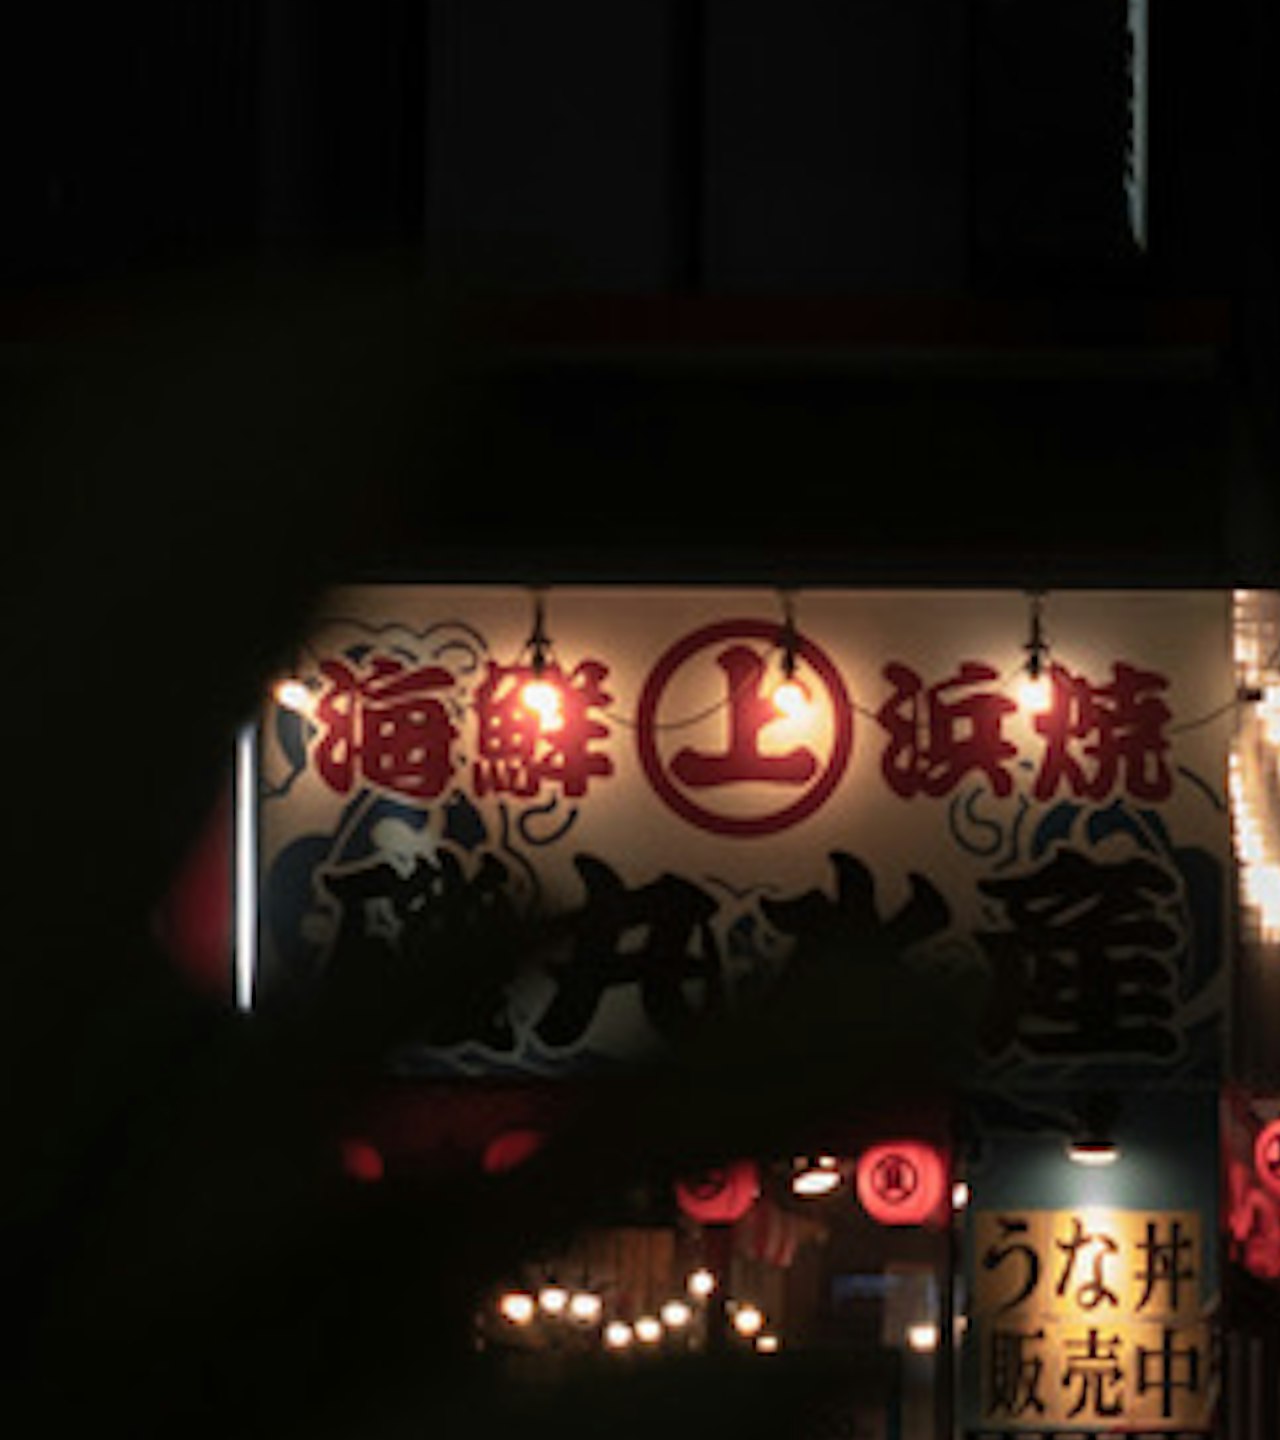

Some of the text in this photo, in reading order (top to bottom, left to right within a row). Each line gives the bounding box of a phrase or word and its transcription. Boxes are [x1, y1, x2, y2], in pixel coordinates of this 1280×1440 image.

[312, 658, 615, 800] 海鮮
[880, 660, 1175, 803] 浜焼
[983, 1217, 1196, 1313] うな丼
[984, 1326, 1200, 1420] 販売中
